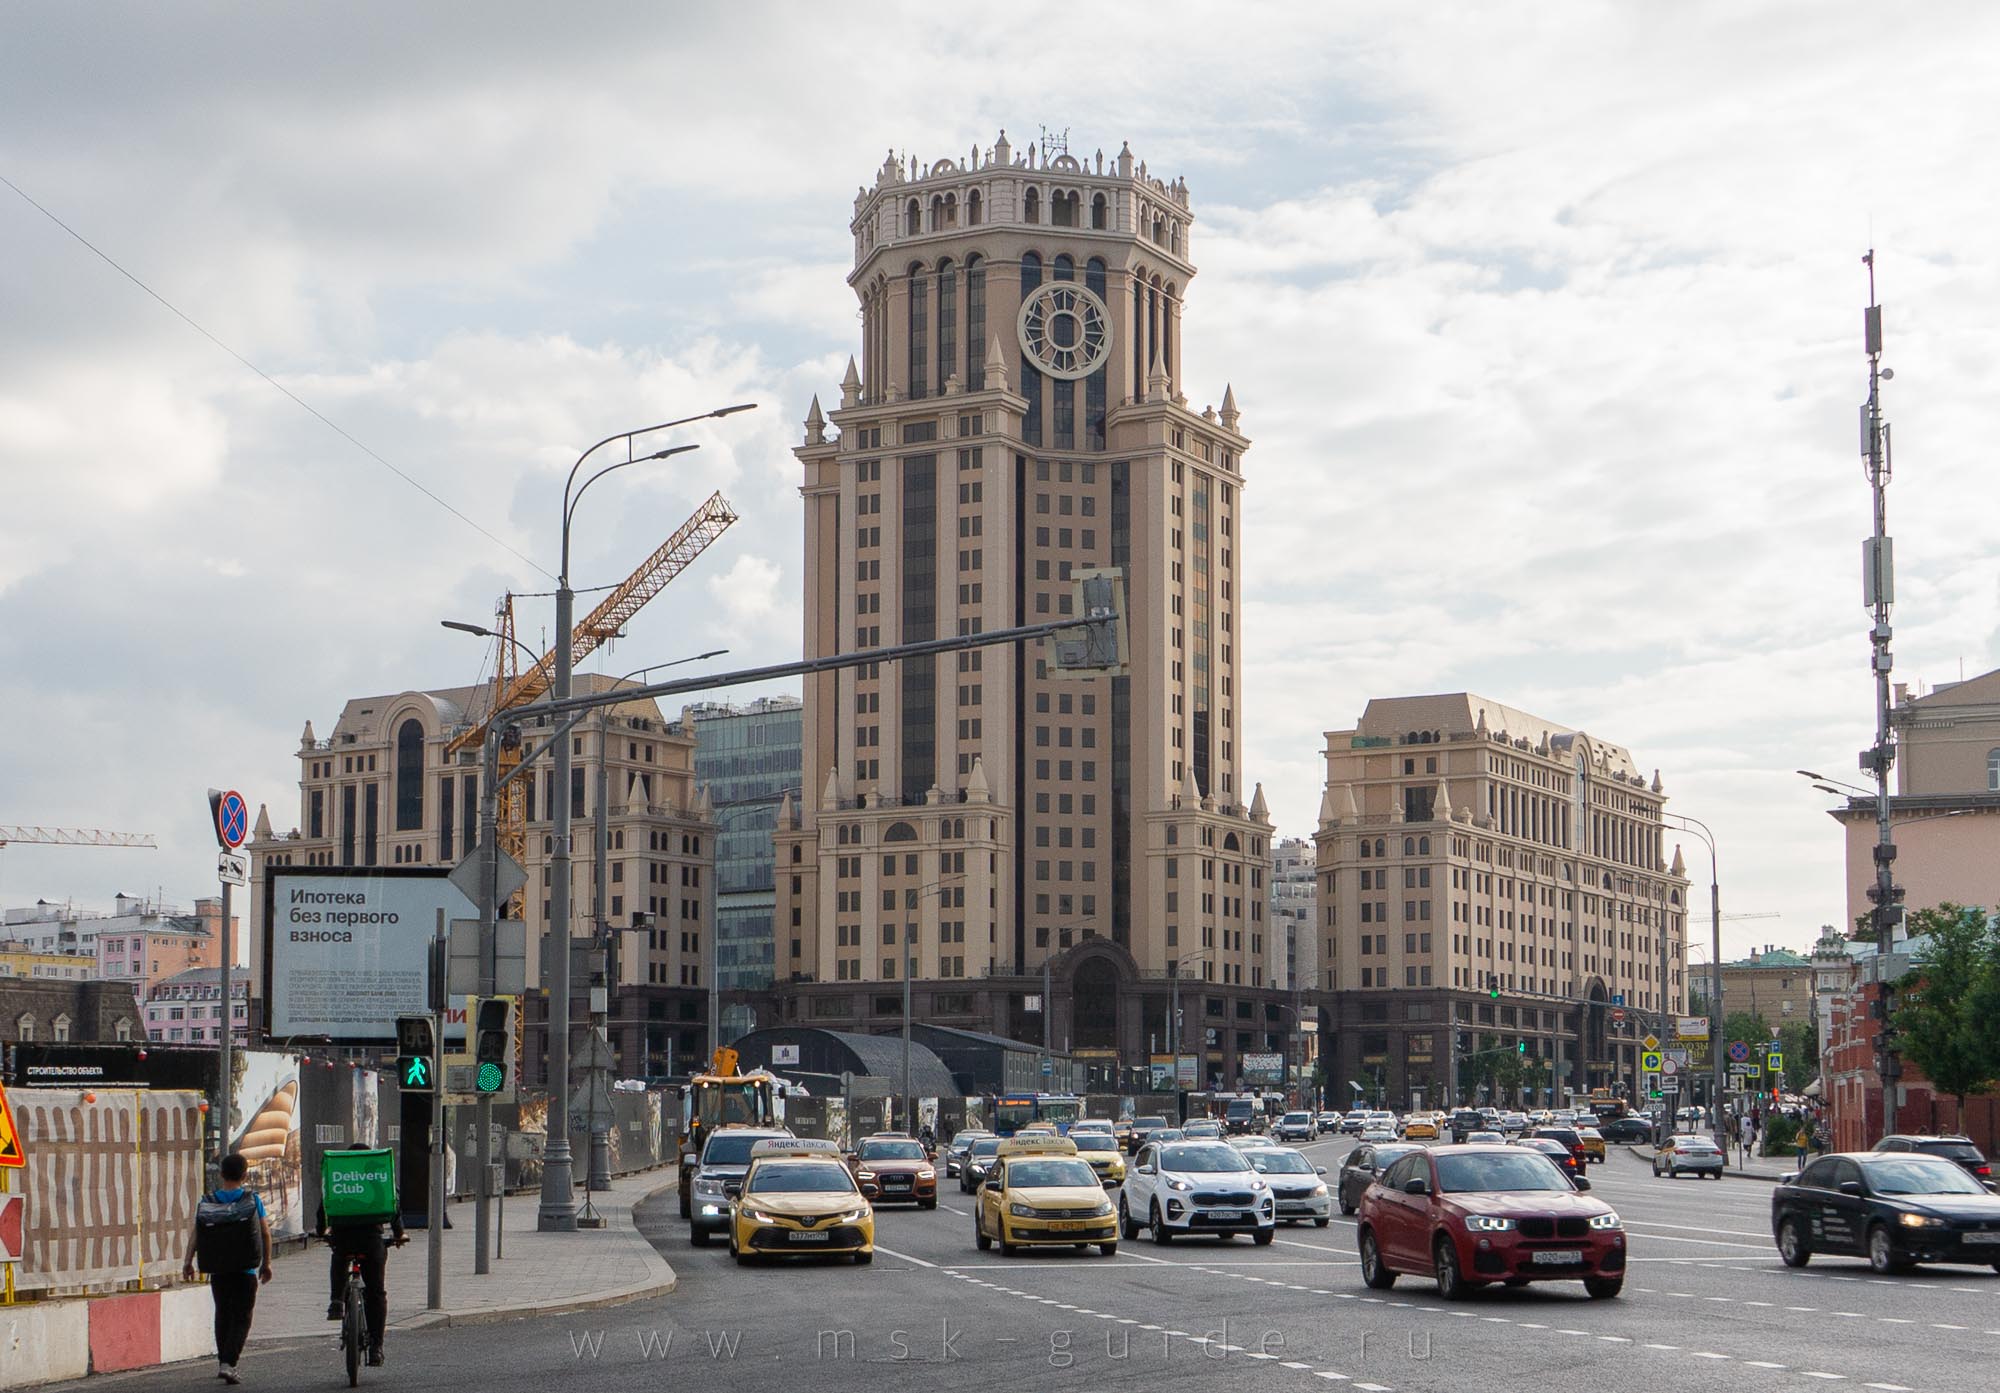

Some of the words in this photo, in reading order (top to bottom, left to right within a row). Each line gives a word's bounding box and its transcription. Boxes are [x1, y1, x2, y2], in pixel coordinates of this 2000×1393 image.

[290, 889, 366, 905] Ипотека
[290, 907, 322, 924] без
[326, 911, 399, 927] первого
[290, 931, 352, 943] взноса
[27, 1066, 78, 1075] СТРОИТЕЛЬСТВО
[78, 1066, 104, 1075] ОБЪЕКТА
[767, 1140, 800, 1149] Яндекс
[802, 1140, 827, 1149] Такси
[1010, 1138, 1040, 1147] Яндекс
[1043, 1137, 1066, 1145] Такси
[332, 1171, 388, 1182] Delivery
[332, 1183, 365, 1194] Club
